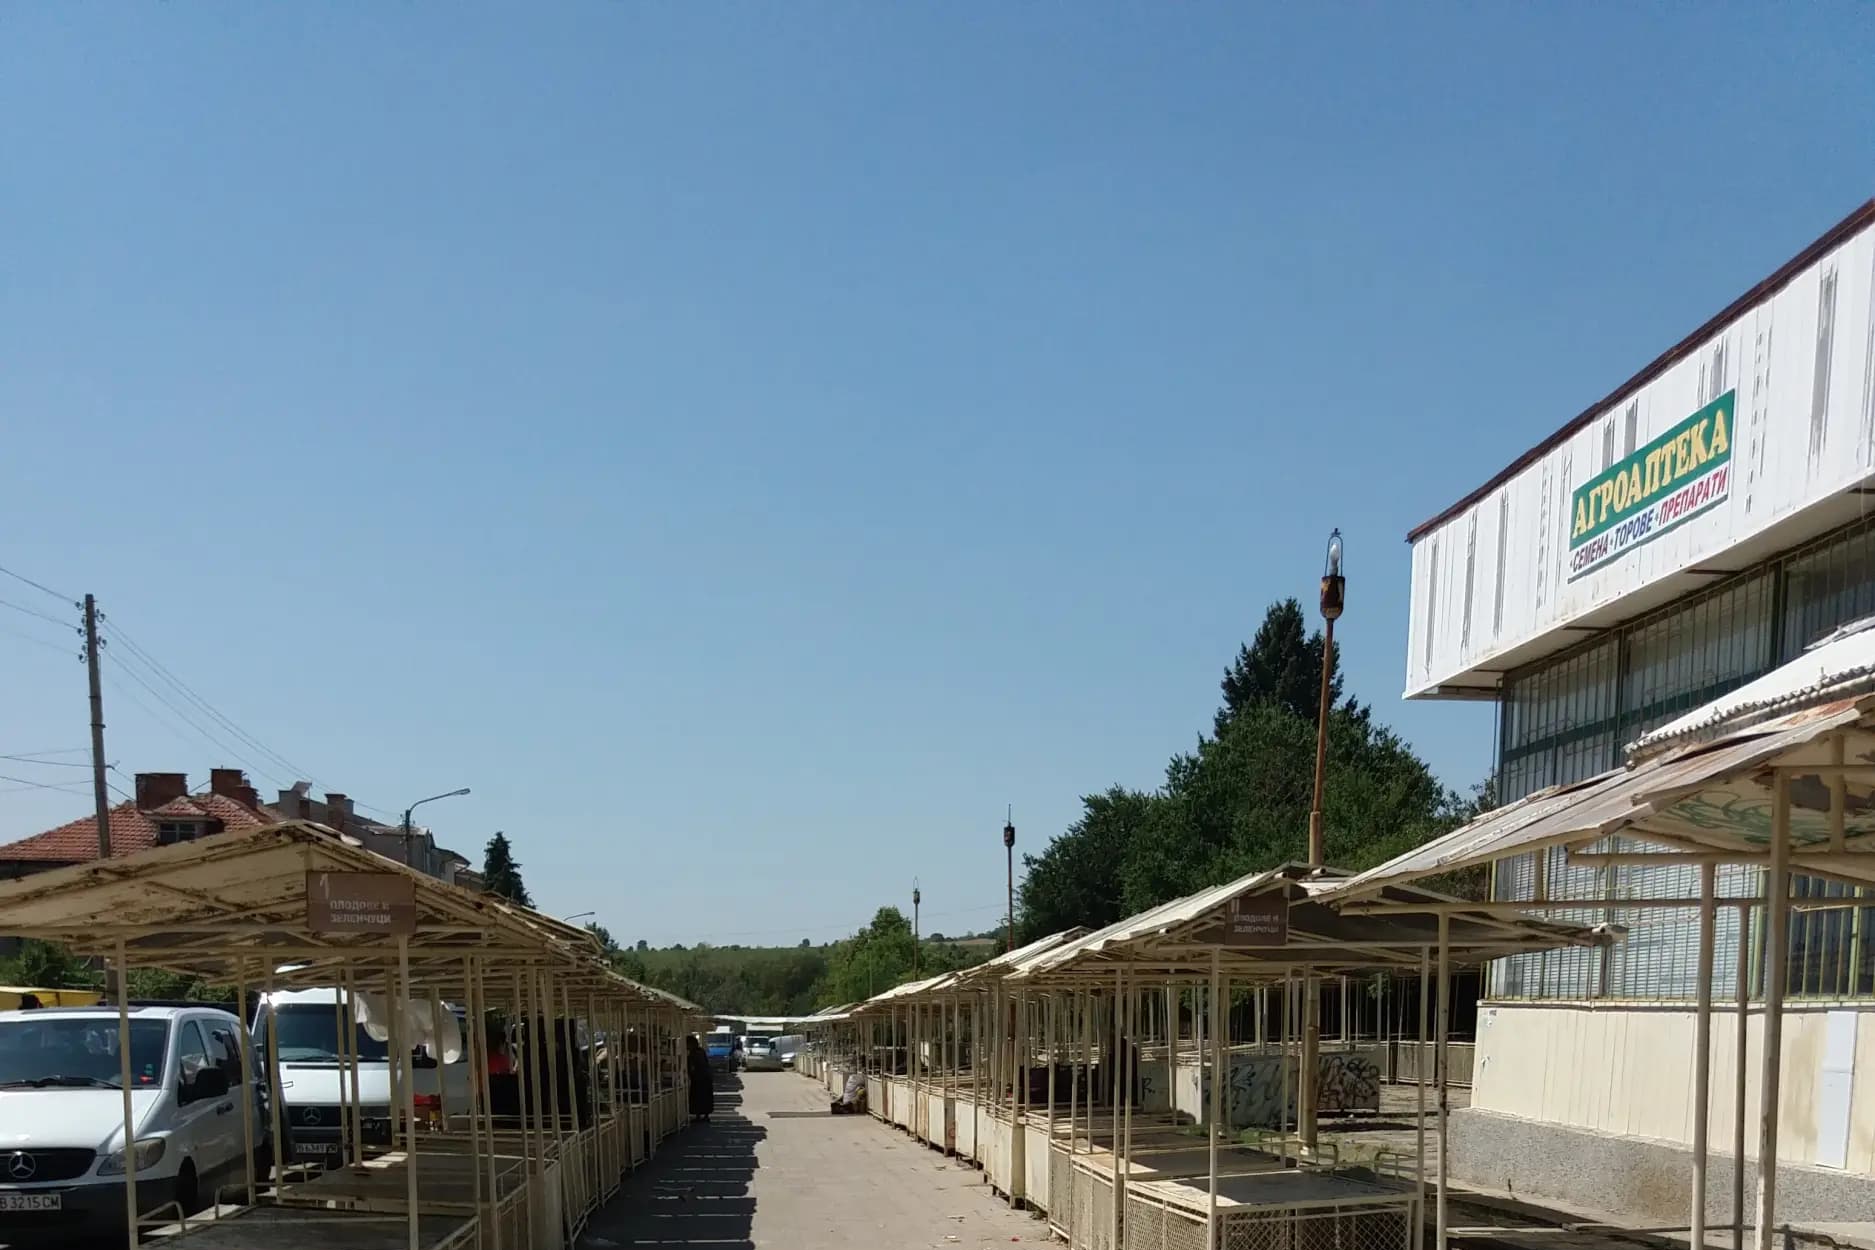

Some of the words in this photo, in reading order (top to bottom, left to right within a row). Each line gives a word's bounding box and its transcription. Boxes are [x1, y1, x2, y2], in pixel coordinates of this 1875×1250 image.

[1572, 409, 1729, 539] АГРОАПТЕКА
[1573, 534, 1609, 573] СЕМЕНА
[1614, 508, 1655, 550] ТОРОВЕ
[1658, 466, 1728, 526] ПРЕПАРАТИ
